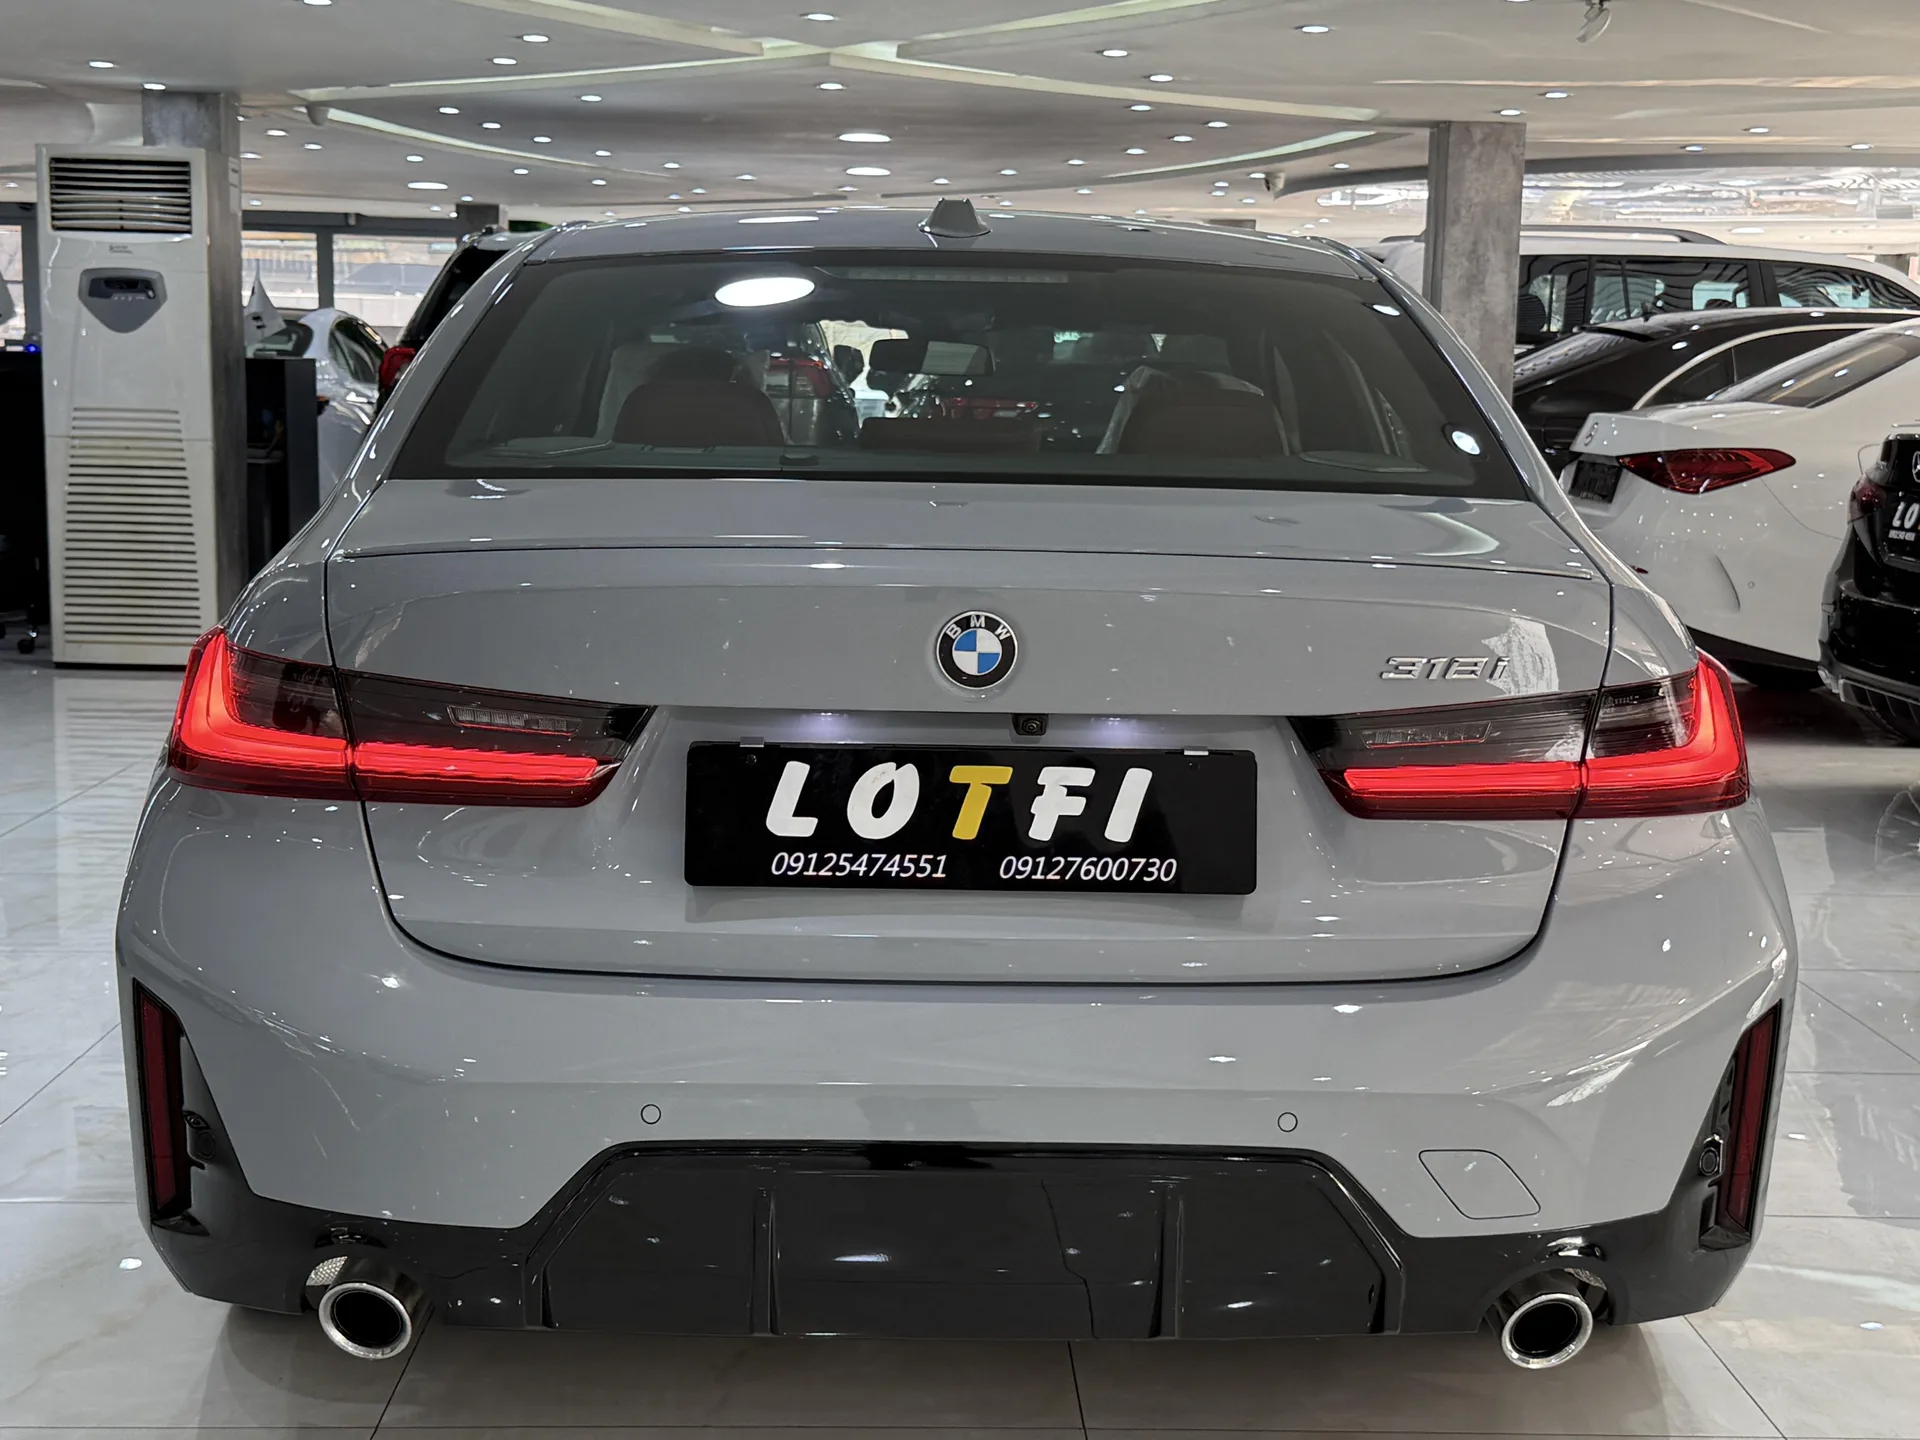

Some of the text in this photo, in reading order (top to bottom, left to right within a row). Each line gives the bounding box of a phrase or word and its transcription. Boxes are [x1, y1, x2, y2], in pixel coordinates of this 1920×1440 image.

[1892, 501, 1920, 529] LO
[945, 614, 1012, 641] BMW
[1379, 656, 1511, 681] 318i
[766, 761, 1153, 843] LOTFI
[771, 852, 1177, 882] 09125474551 09127600730
